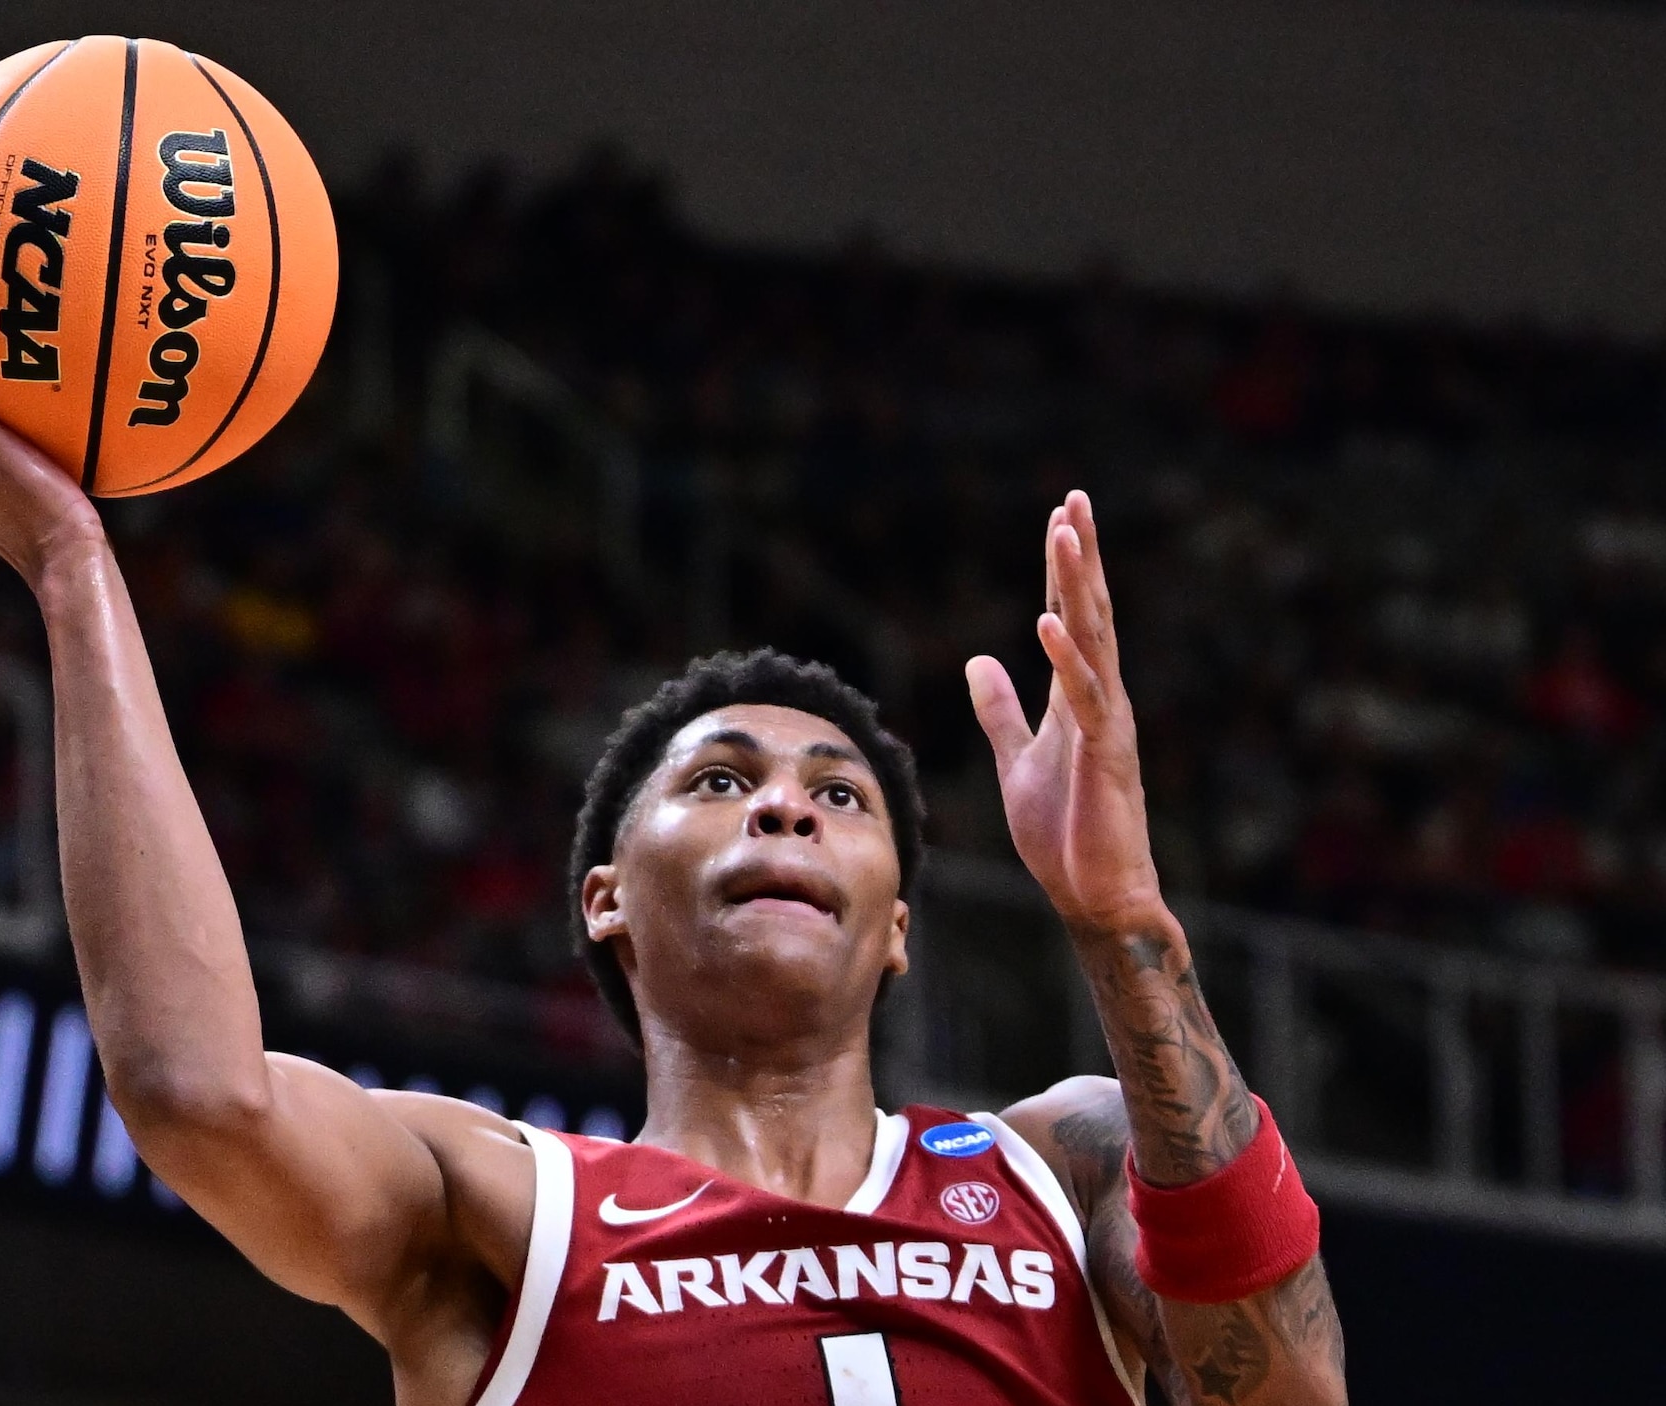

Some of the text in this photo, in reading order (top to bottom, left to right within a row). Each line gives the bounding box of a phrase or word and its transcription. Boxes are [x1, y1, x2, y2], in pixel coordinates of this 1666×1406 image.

[128, 128, 235, 427] Wilson
[137, 234, 157, 330] EVO NXT
[933, 1130, 991, 1151] NCAA
[944, 1184, 994, 1220] SEC
[597, 1241, 1056, 1321] ARKANSAS
